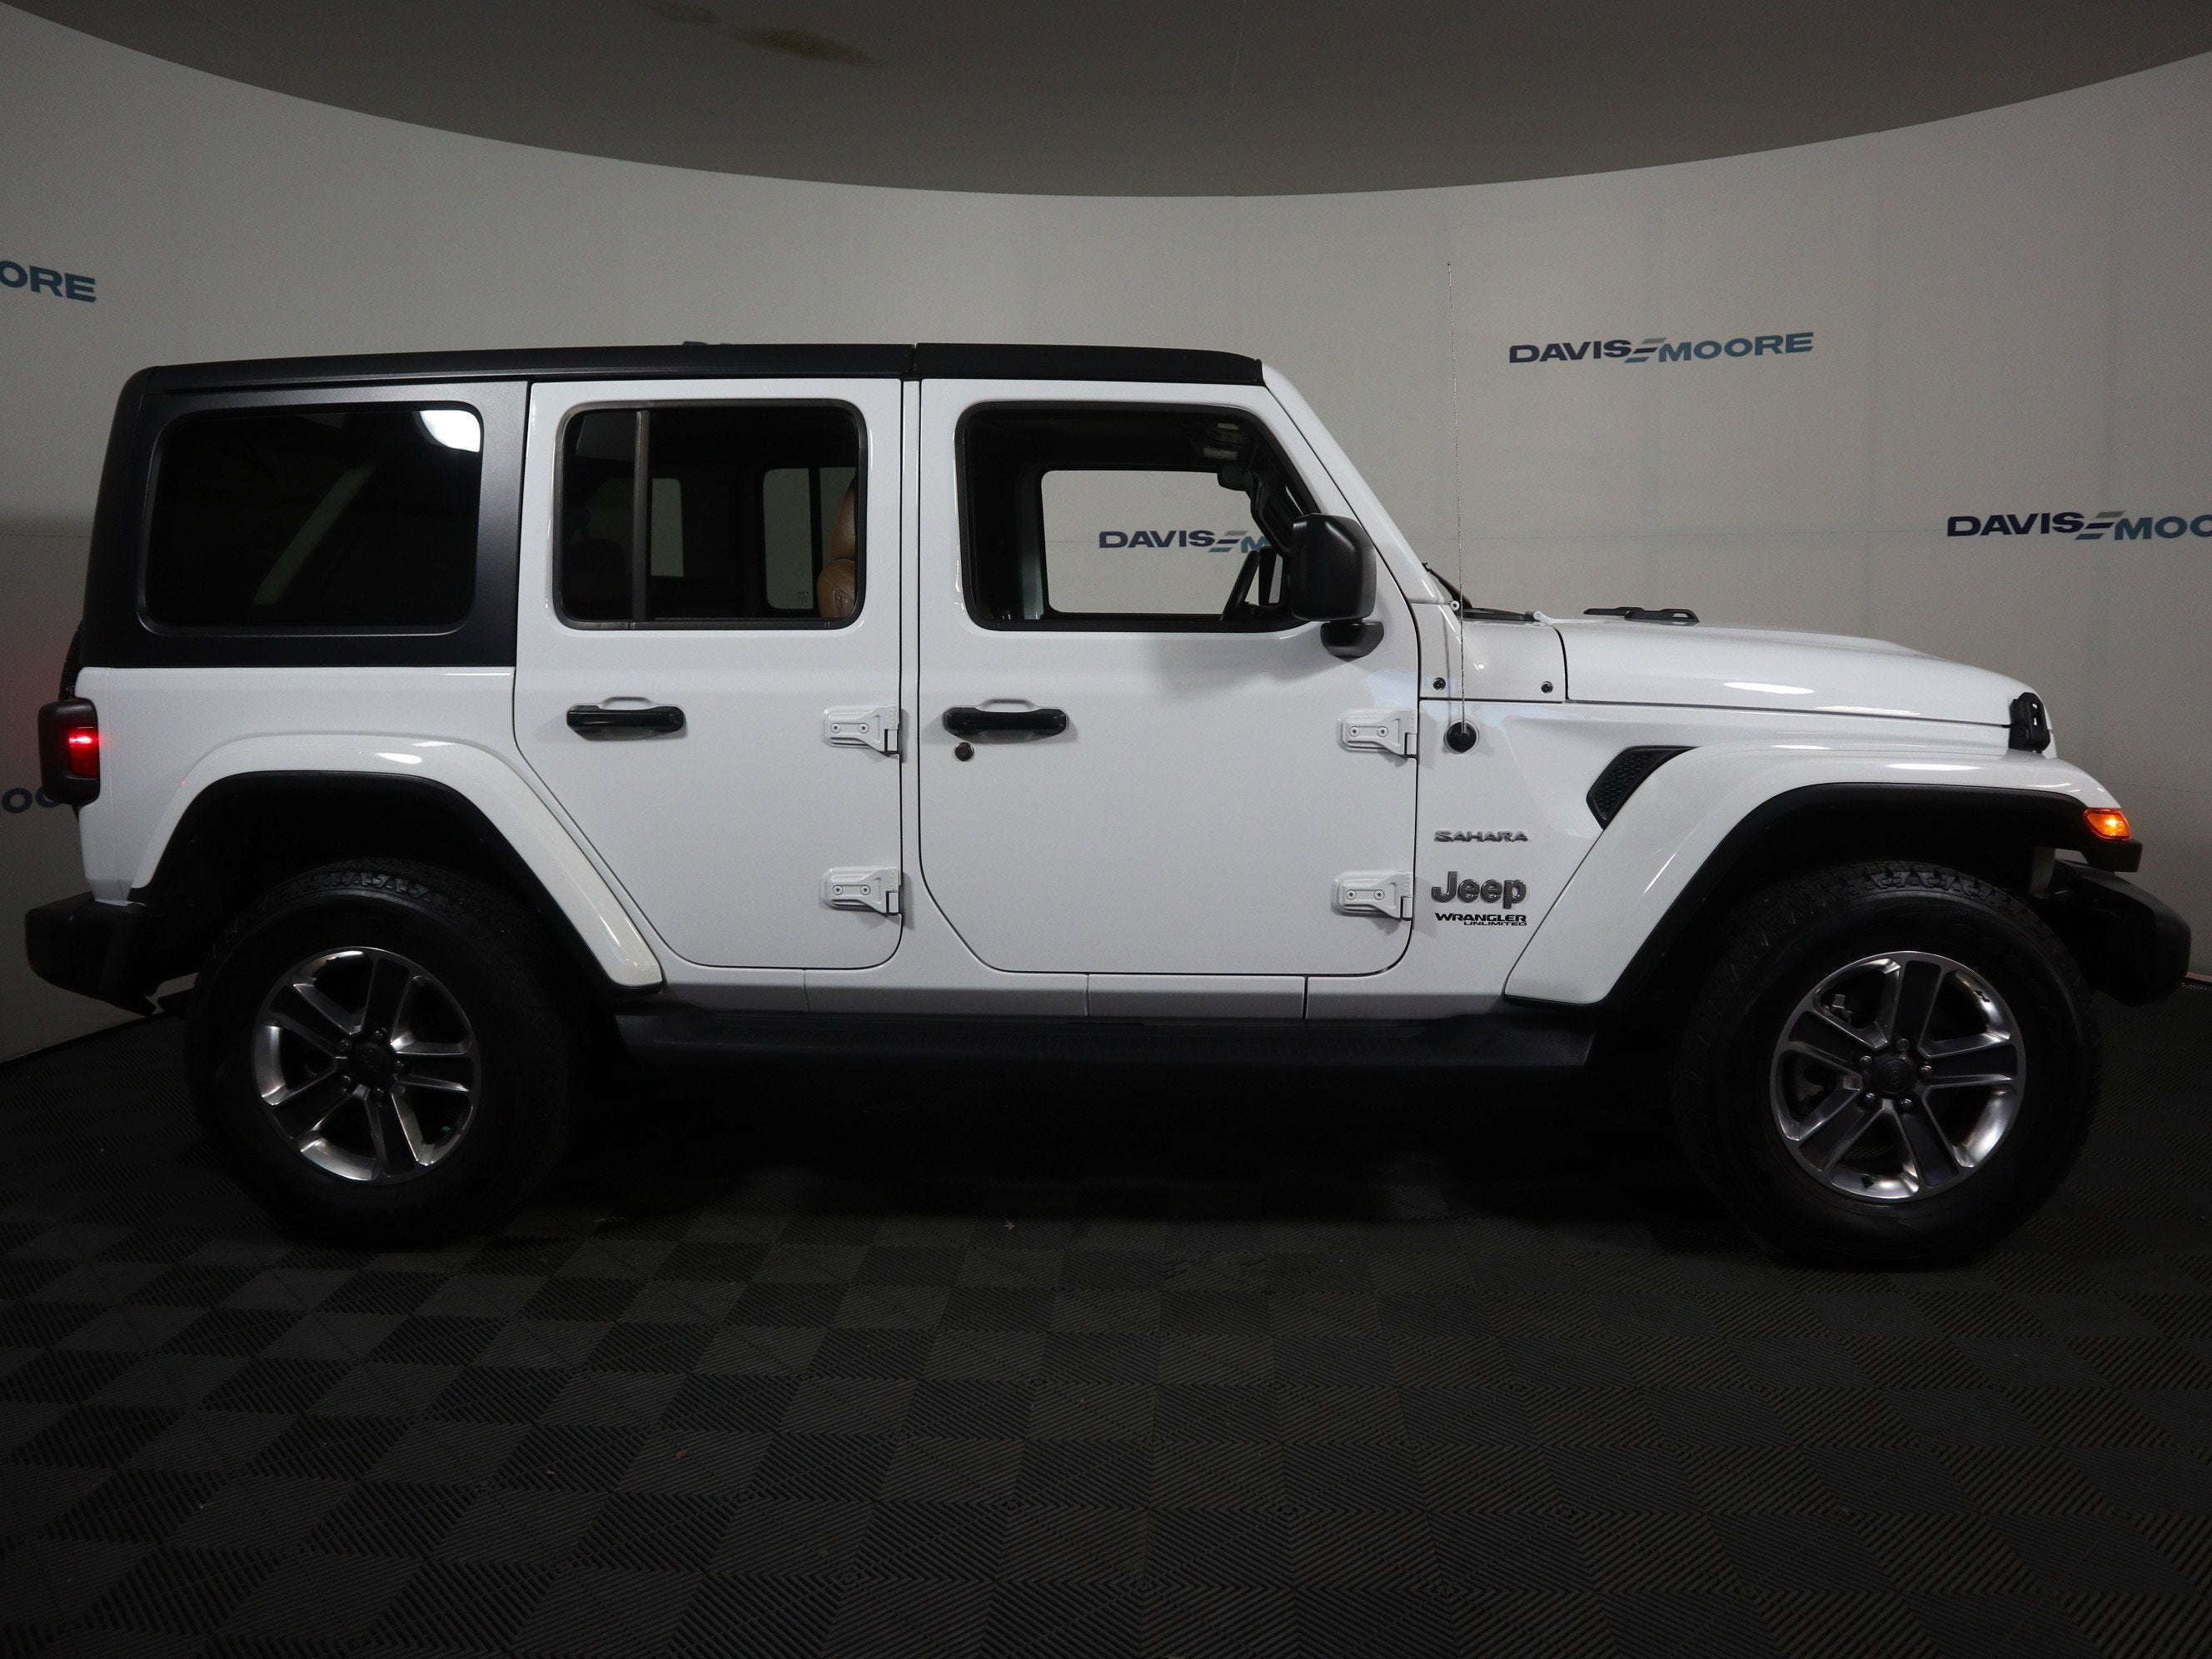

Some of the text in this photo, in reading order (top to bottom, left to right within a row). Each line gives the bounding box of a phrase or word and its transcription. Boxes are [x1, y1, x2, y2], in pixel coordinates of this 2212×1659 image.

[0, 261, 97, 302] ORE
[1509, 332, 1814, 363] DAVIS MOORE
[1099, 531, 1215, 548] DAVIS
[1947, 511, 2212, 540] DAVIS MOO
[1434, 830, 1528, 842] SAHARA
[1431, 871, 1527, 909] Jeep
[1435, 913, 1527, 922] WRANGLER
